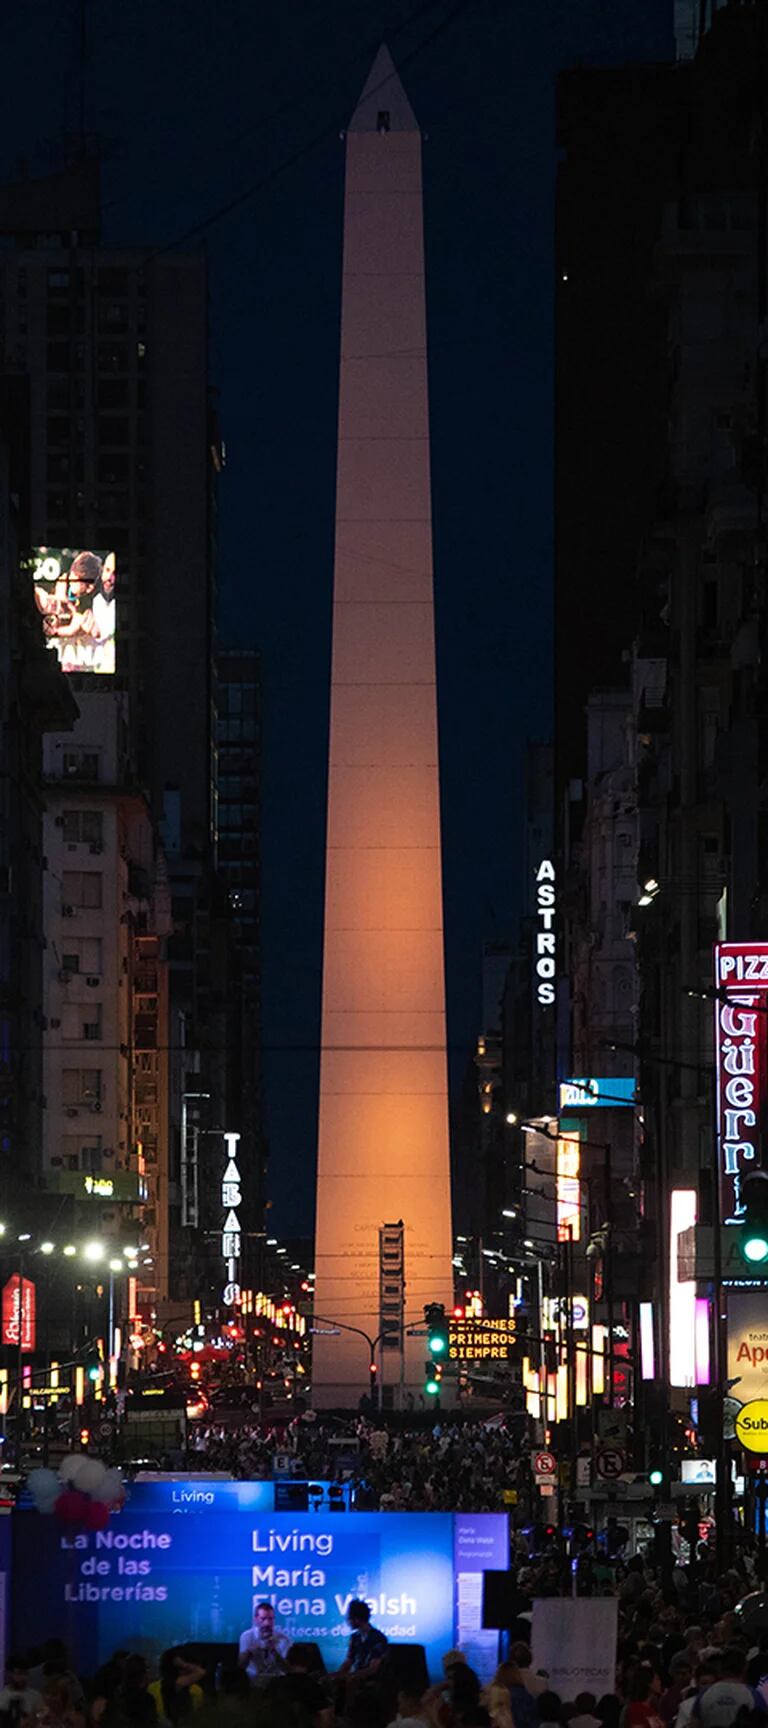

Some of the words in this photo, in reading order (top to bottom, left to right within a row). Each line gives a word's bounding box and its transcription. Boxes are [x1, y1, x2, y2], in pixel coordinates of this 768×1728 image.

[536, 860, 556, 1004] ASTROS
[222, 1132, 243, 1306] TABARIS
[449, 1334, 517, 1345] PRIMEROS
[449, 1347, 508, 1358] SIEMPRE
[172, 1490, 214, 1504] Living
[96, 1530, 172, 1549] Noche
[252, 1530, 333, 1555] Living
[81, 1557, 109, 1576] de
[118, 1557, 151, 1576] las
[252, 1564, 326, 1587] María
[65, 1583, 168, 1602] Librerías
